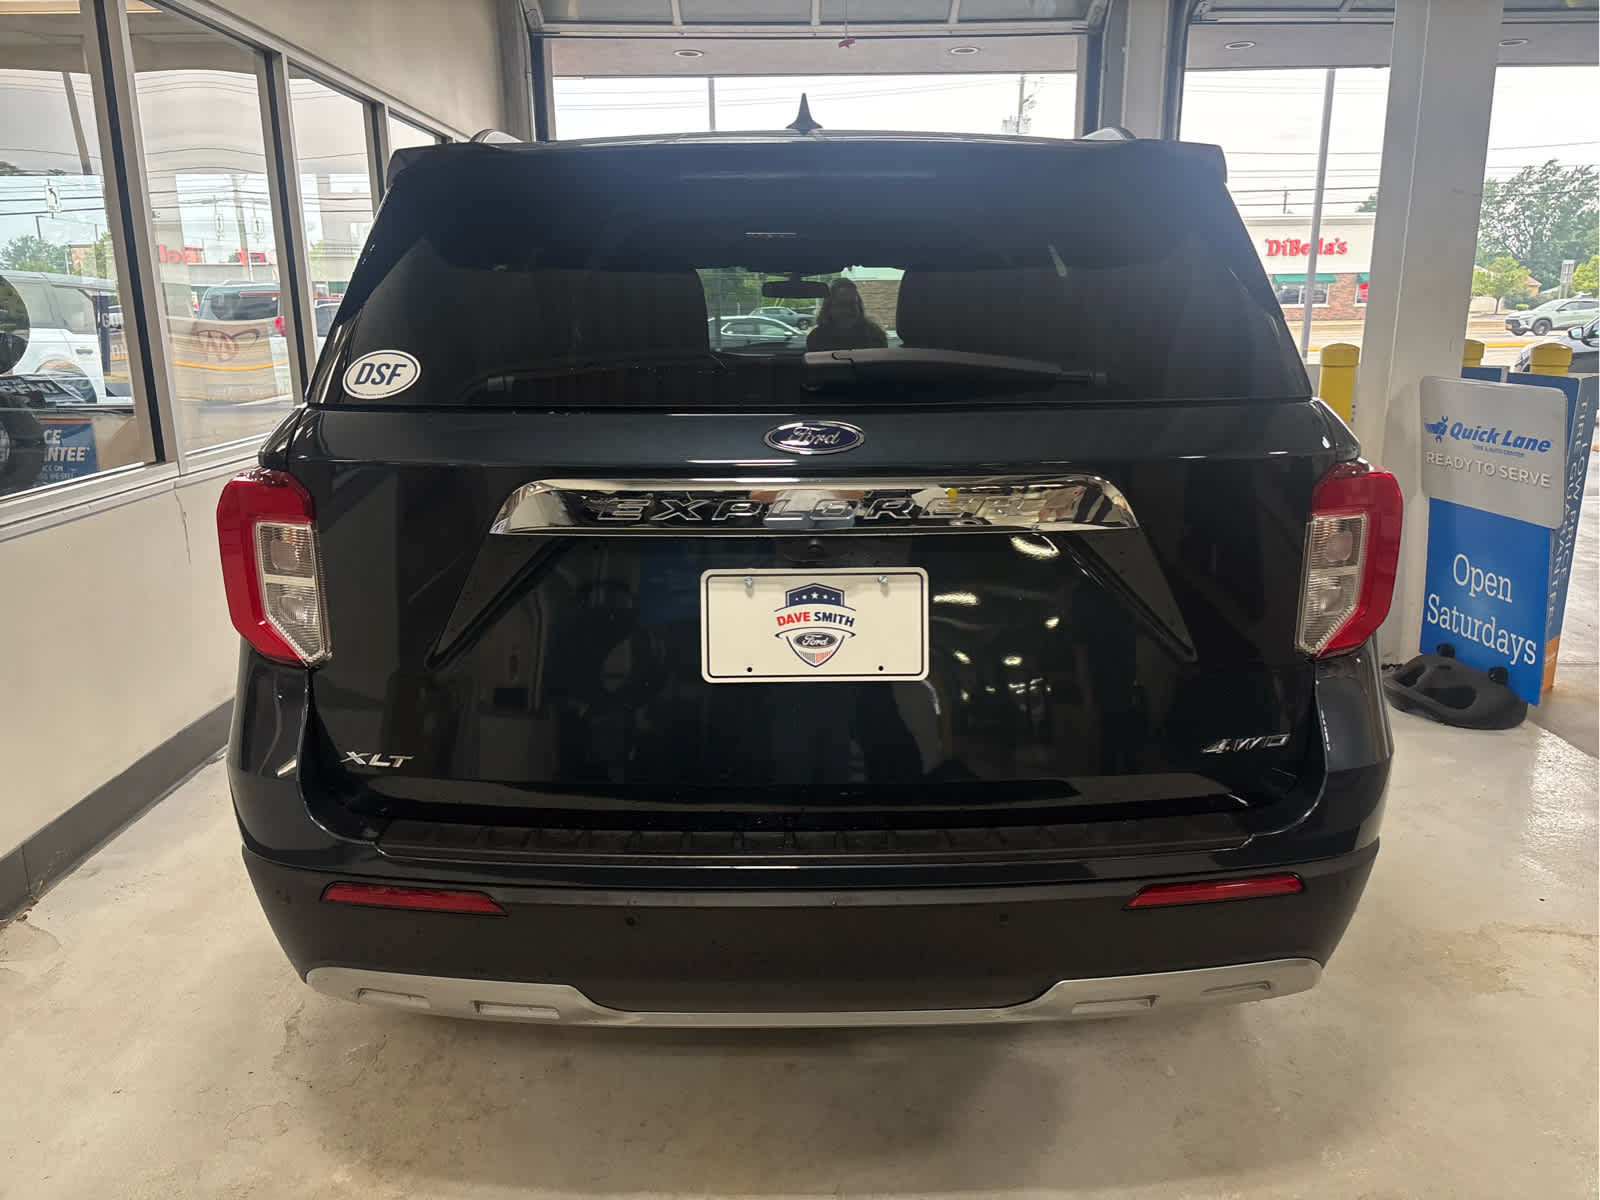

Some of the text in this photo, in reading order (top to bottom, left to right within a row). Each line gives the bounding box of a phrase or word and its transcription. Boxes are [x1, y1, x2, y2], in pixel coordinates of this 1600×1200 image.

[1265, 237, 1348, 256] DiBela's
[354, 363, 408, 385] DSF
[788, 426, 841, 445] Ford
[1450, 422, 1501, 445] Quick
[1501, 430, 1552, 453] Lane
[1426, 452, 1552, 488] READY TO SERVE
[597, 497, 1034, 523] EXPLORER
[1561, 441, 1589, 577] LOW PRICE
[1453, 553, 1513, 603] Open
[776, 611, 855, 628] DAVE SMITH
[1427, 593, 1537, 665] Saturdays
[802, 633, 829, 646] Ford
[1202, 733, 1290, 754] 4WD
[340, 751, 415, 768] XLT
